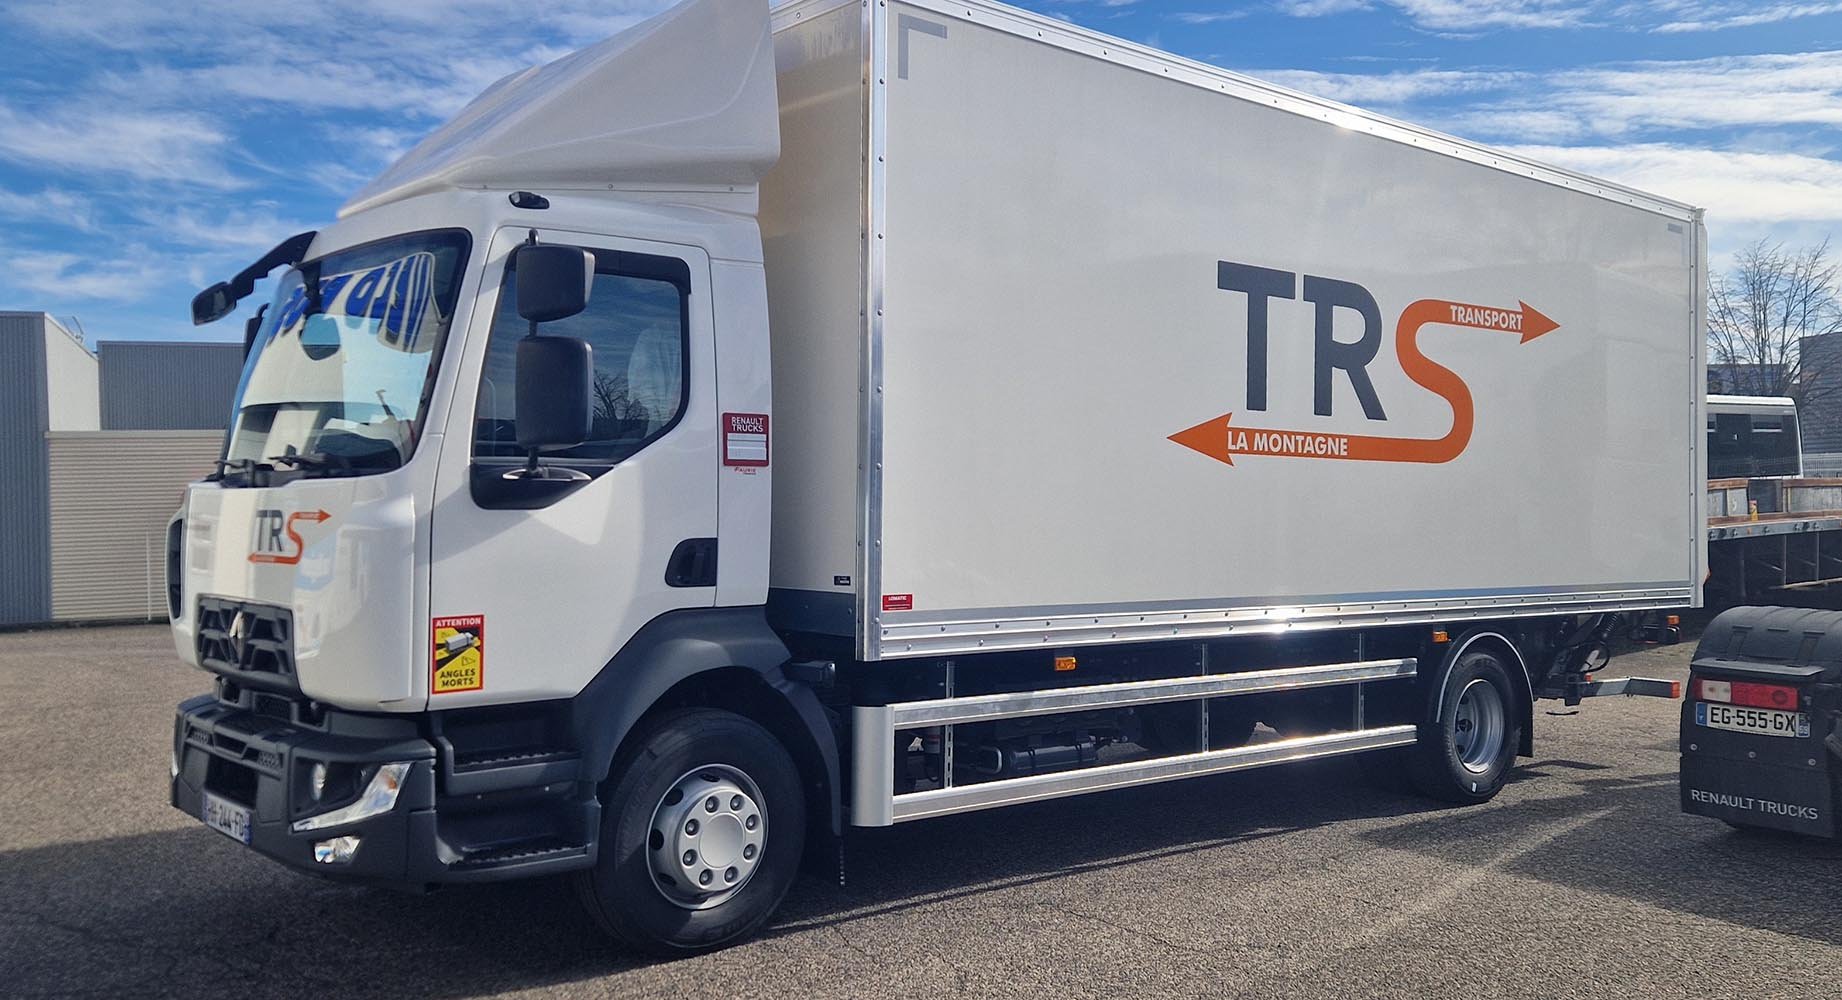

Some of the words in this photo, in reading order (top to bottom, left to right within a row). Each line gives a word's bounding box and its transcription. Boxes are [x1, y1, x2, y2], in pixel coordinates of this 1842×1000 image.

[1449, 305, 1523, 331] TRANSPORT
[1217, 259, 1474, 464] TRS
[731, 416, 764, 425] RENAULT
[732, 423, 764, 432] TRUCKS
[1227, 430, 1249, 451] LA
[1253, 432, 1348, 456] MONTAGNE
[255, 509, 305, 565] TRS
[435, 617, 482, 627] ATTENTION
[439, 668, 476, 679] ANGLES
[441, 678, 475, 688] MORTS
[1710, 706, 1796, 732] EG-555-GX
[1691, 789, 1755, 810] RENAULT
[1757, 799, 1819, 820] TRUCKS
